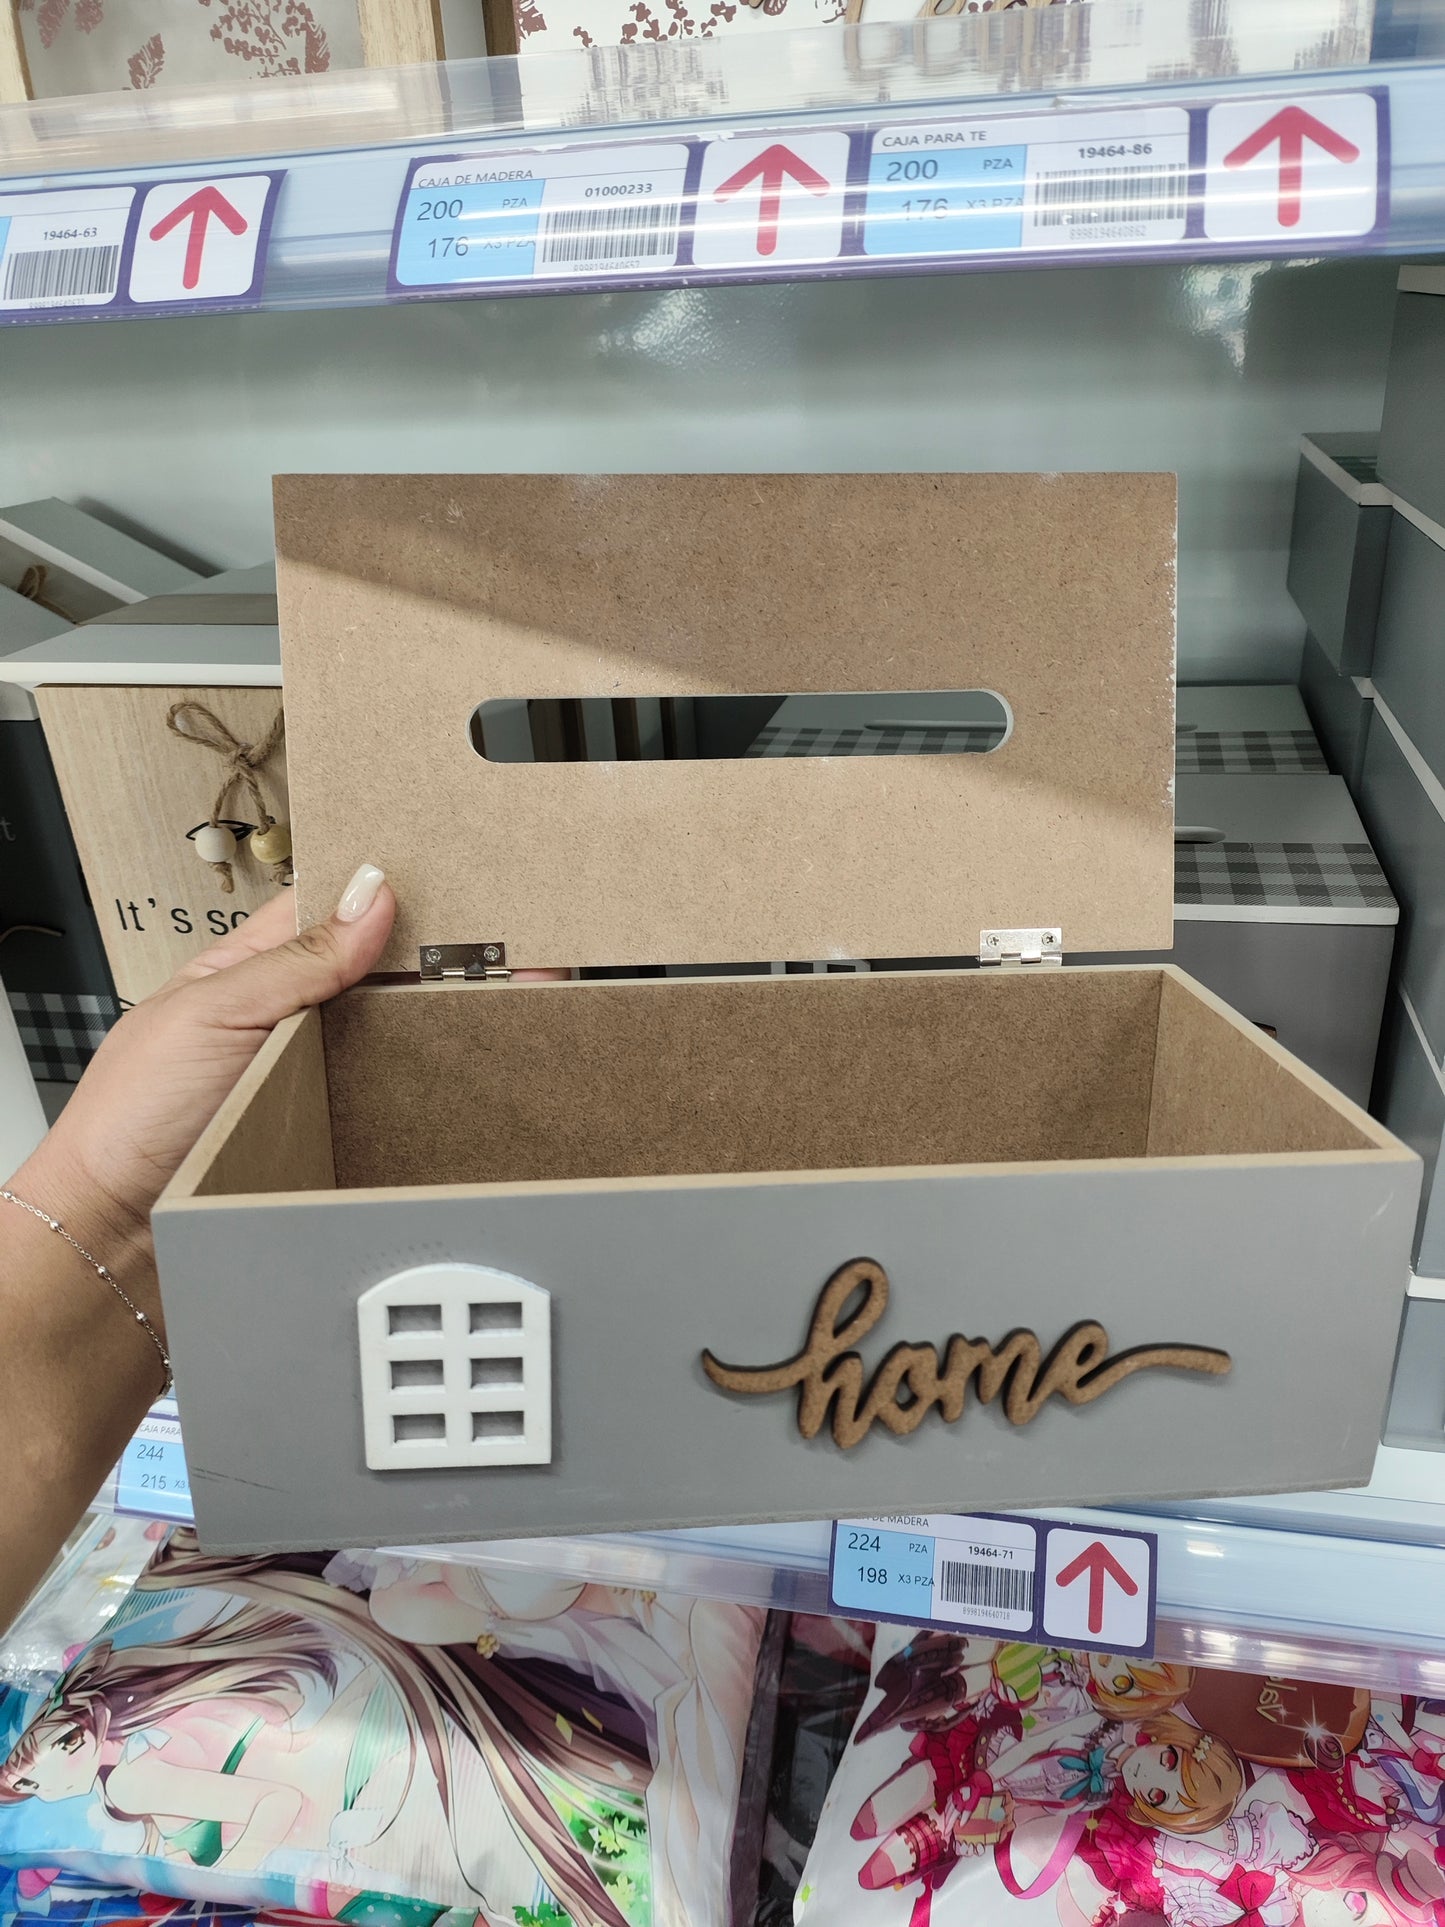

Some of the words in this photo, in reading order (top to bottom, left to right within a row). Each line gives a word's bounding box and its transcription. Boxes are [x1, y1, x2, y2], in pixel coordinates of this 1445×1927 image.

[882, 136, 920, 147] CAJA
[924, 132, 965, 144] PARA
[970, 131, 987, 141] TE
[1078, 143, 1153, 159] 19464-86
[886, 159, 938, 182] 200
[983, 158, 1013, 170] PZA
[418, 177, 450, 189] CAJA
[455, 174, 472, 185] DE
[475, 170, 533, 183] MADERA
[585, 183, 653, 198] 01000233
[417, 199, 464, 221] 200
[502, 198, 527, 208] PZA
[902, 198, 949, 221] 176
[43, 227, 98, 240] 19464-63
[428, 236, 469, 258] 176
[702, 1256, 1232, 1449] home
[140, 1424, 159, 1434] CAJA
[136, 1444, 164, 1460] 244
[141, 1473, 167, 1490] 215
[887, 1515, 930, 1528] MADERA
[848, 1532, 881, 1552] 224
[908, 1543, 928, 1554] PZA
[968, 1545, 1014, 1559] 19464-71
[858, 1566, 888, 1585] 198
[897, 1574, 911, 1584] X3
[914, 1575, 935, 1587] PZA
